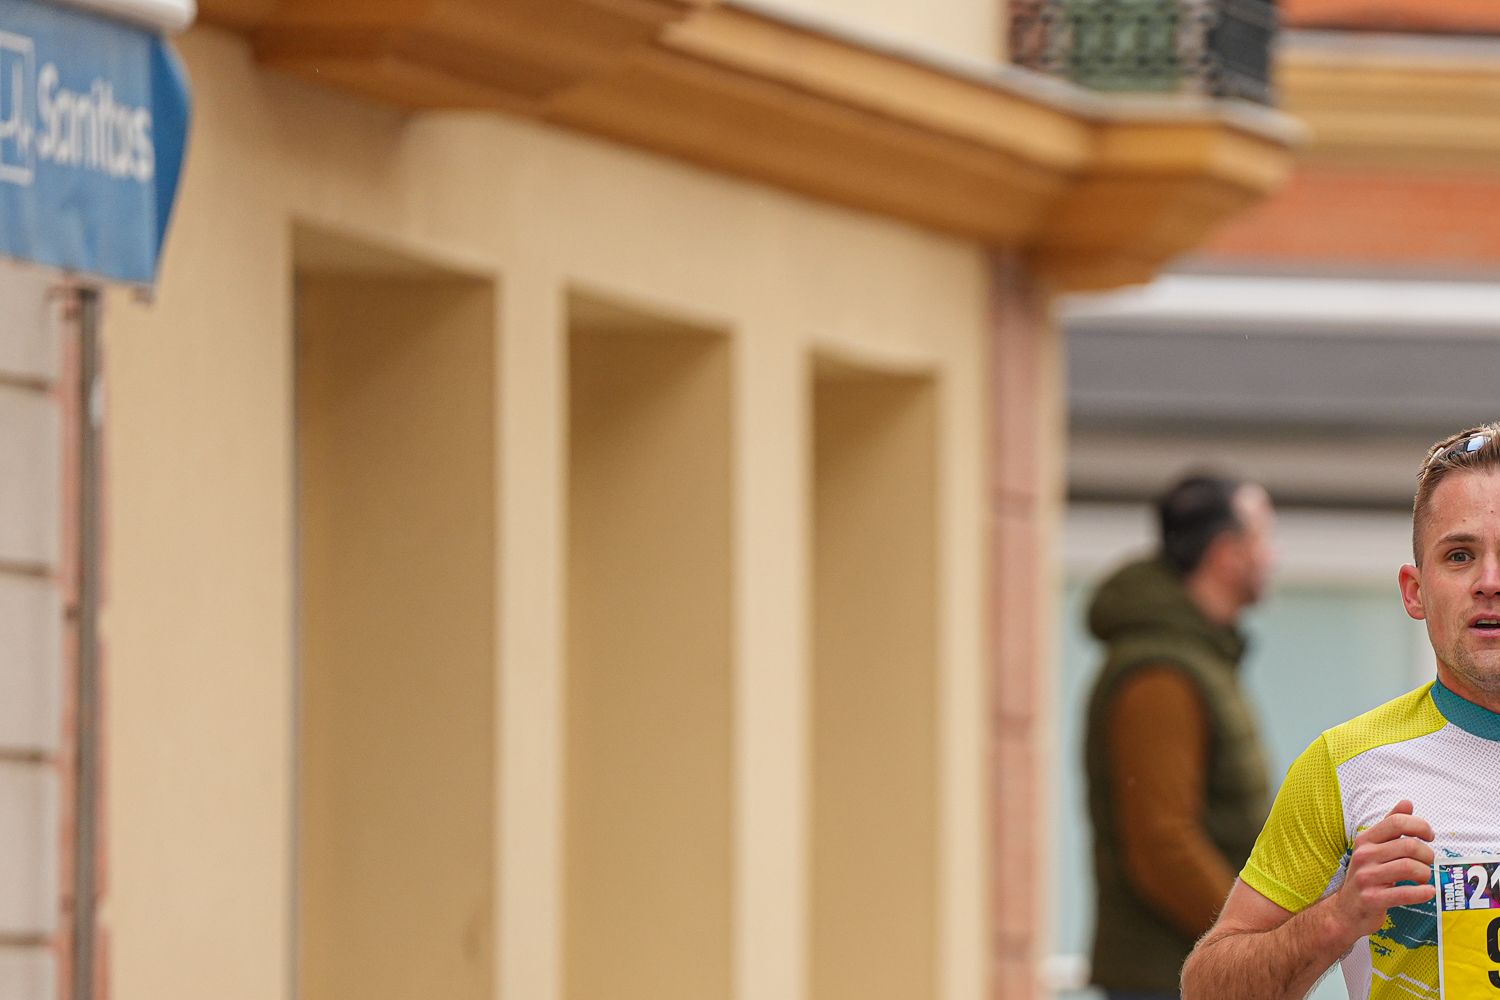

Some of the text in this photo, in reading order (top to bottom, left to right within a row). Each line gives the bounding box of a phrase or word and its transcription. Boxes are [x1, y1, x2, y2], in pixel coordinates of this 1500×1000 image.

[37, 61, 155, 183] Sanitas
[1444, 882, 1455, 911] MEDIA
[1452, 866, 1465, 910] MARATÓN
